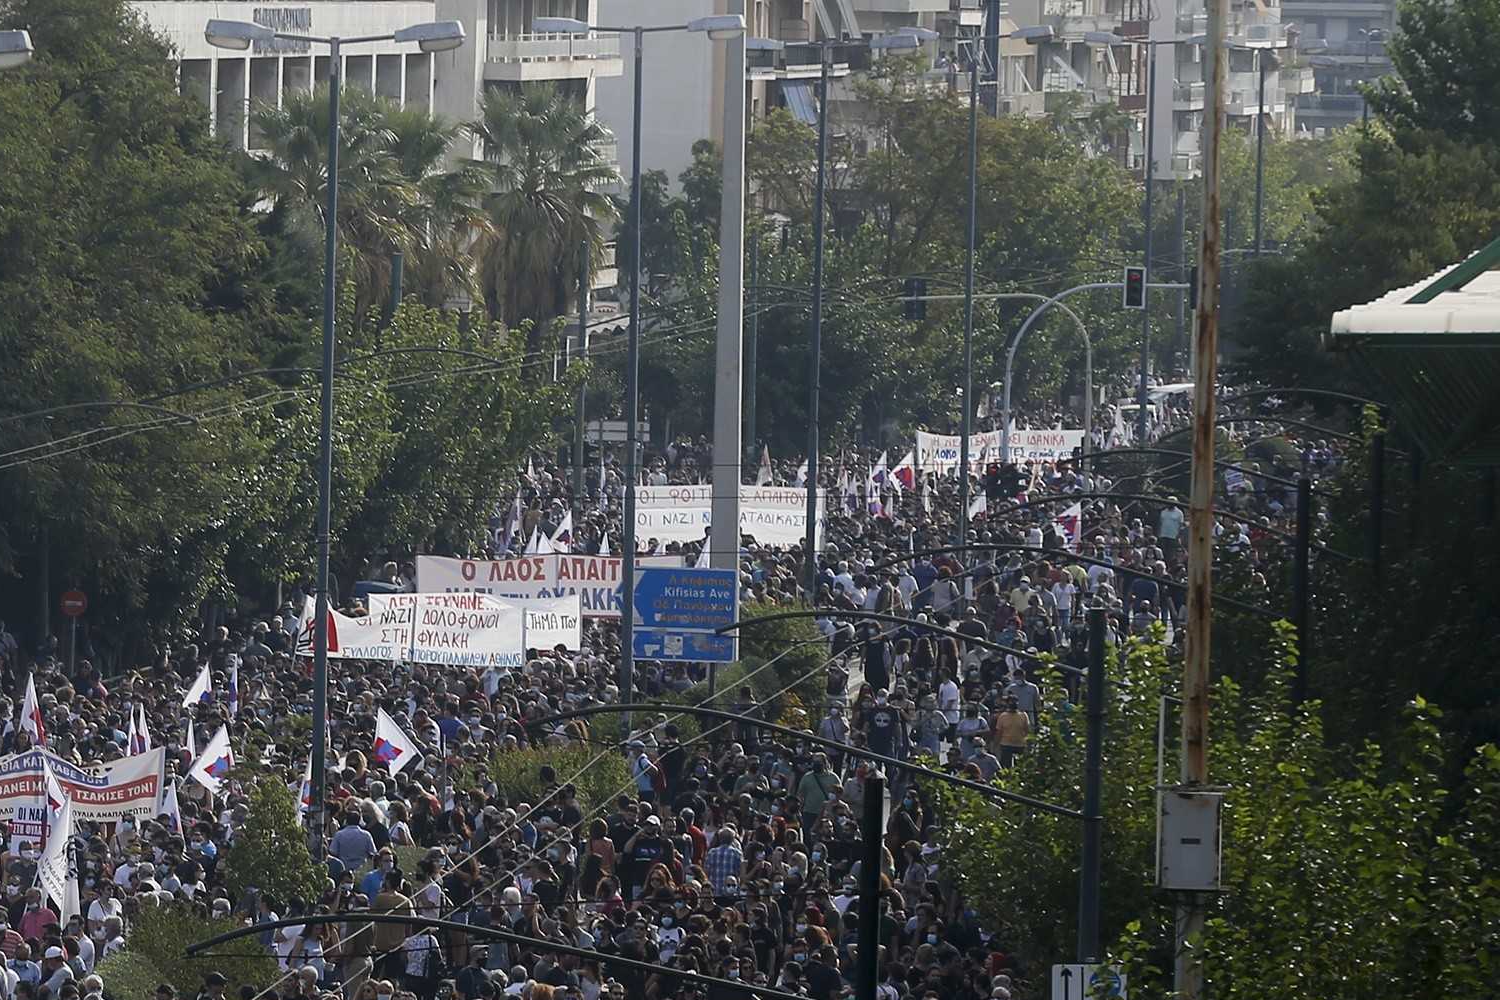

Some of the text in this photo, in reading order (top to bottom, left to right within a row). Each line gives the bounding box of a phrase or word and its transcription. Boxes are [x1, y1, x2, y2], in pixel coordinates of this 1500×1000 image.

[461, 560, 477, 582] Ο
[489, 558, 545, 583] ΛΑΟΣ
[664, 586, 731, 599] Kifisias Ave
[379, 609, 412, 625] ΝΑΖΙ
[422, 609, 501, 629] ΔΟΛΟΦΟΝΟΙ
[381, 628, 470, 649] ΣΤΗ ΦΥΛΑΚΗ
[342, 646, 393, 659] ΣΥΛΛΟΓΟΣ
[75, 788, 125, 802] ΤΣΑΚΙΣΕ
